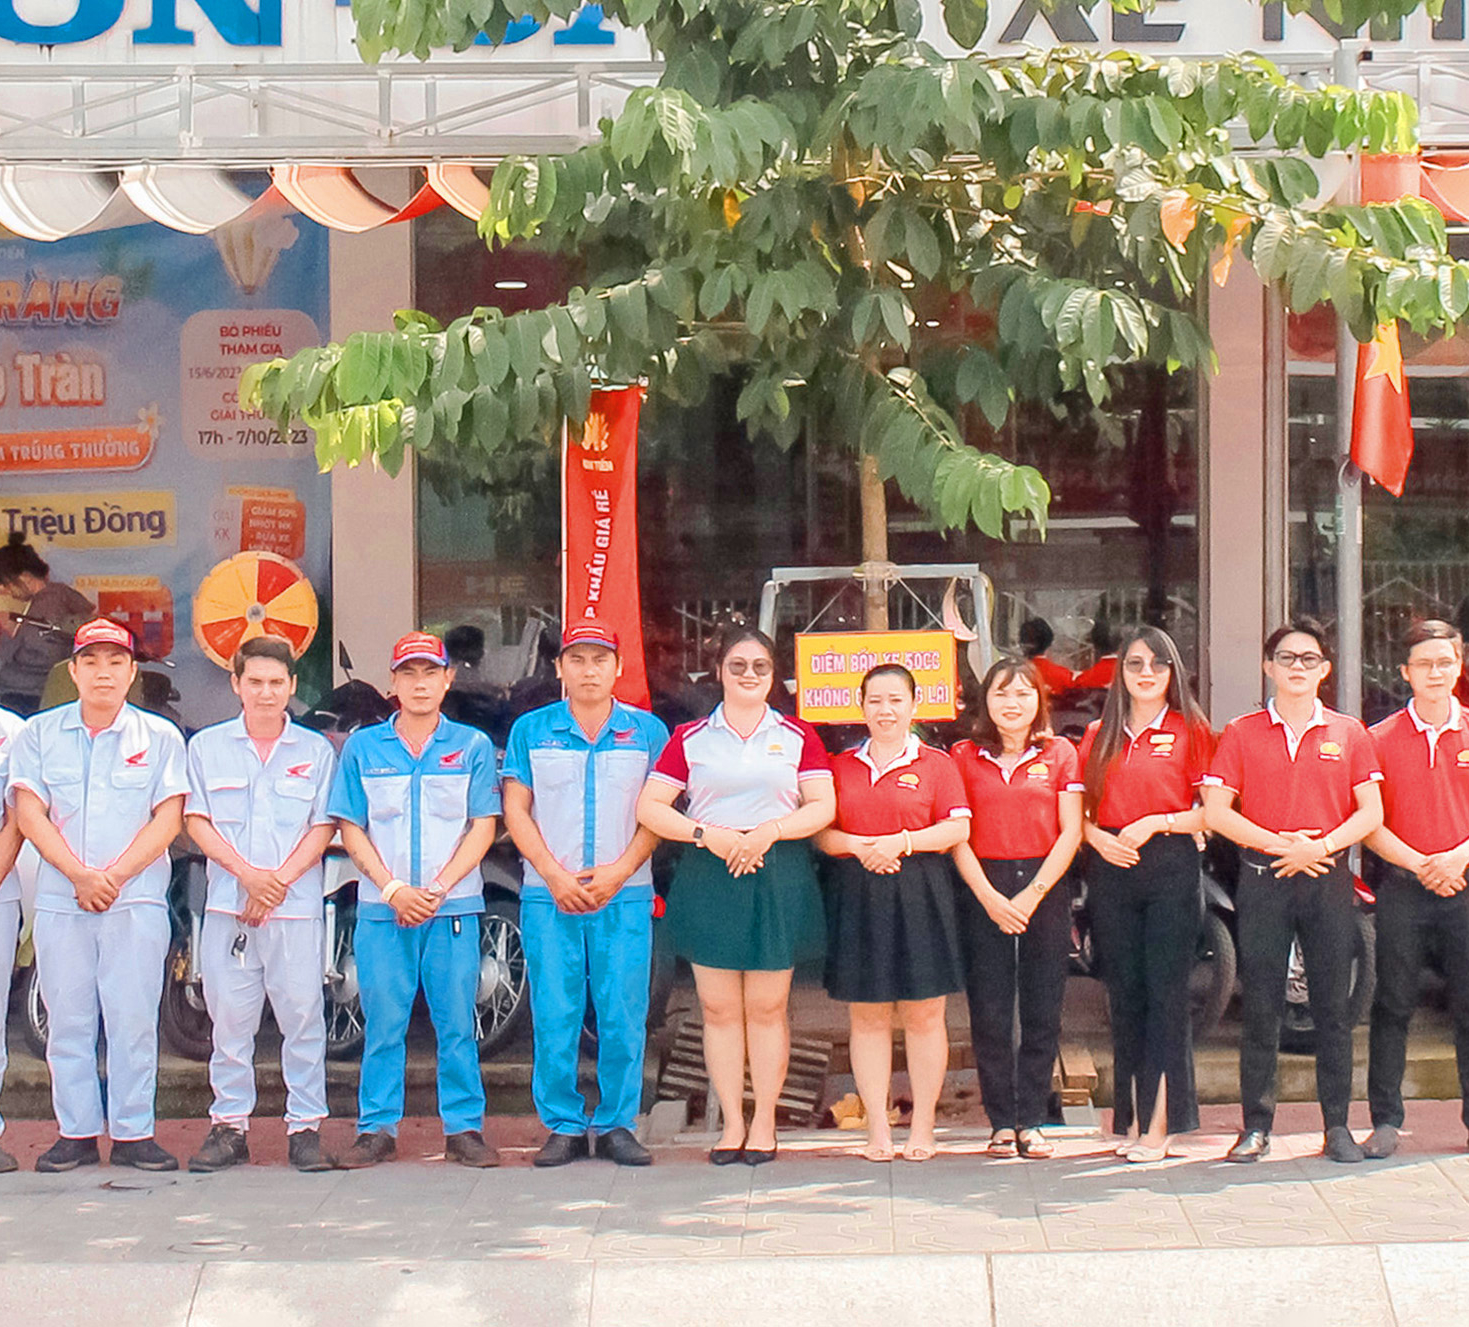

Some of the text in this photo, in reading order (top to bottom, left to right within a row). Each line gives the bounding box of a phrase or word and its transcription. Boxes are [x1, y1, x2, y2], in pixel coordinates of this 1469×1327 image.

[220, 343, 283, 356] THAM GIA
[14, 351, 106, 407] Tràn
[197, 429, 223, 445] 17h
[237, 429, 308, 446] 7/10/223
[2, 506, 76, 542] Triệu
[83, 501, 167, 540] Đồng
[594, 518, 612, 549] GIÁ
[584, 553, 608, 603] KHẨU
[811, 644, 846, 674] ĐIỂM
[904, 651, 941, 671] 50CC
[804, 684, 851, 708] KHÔNG
